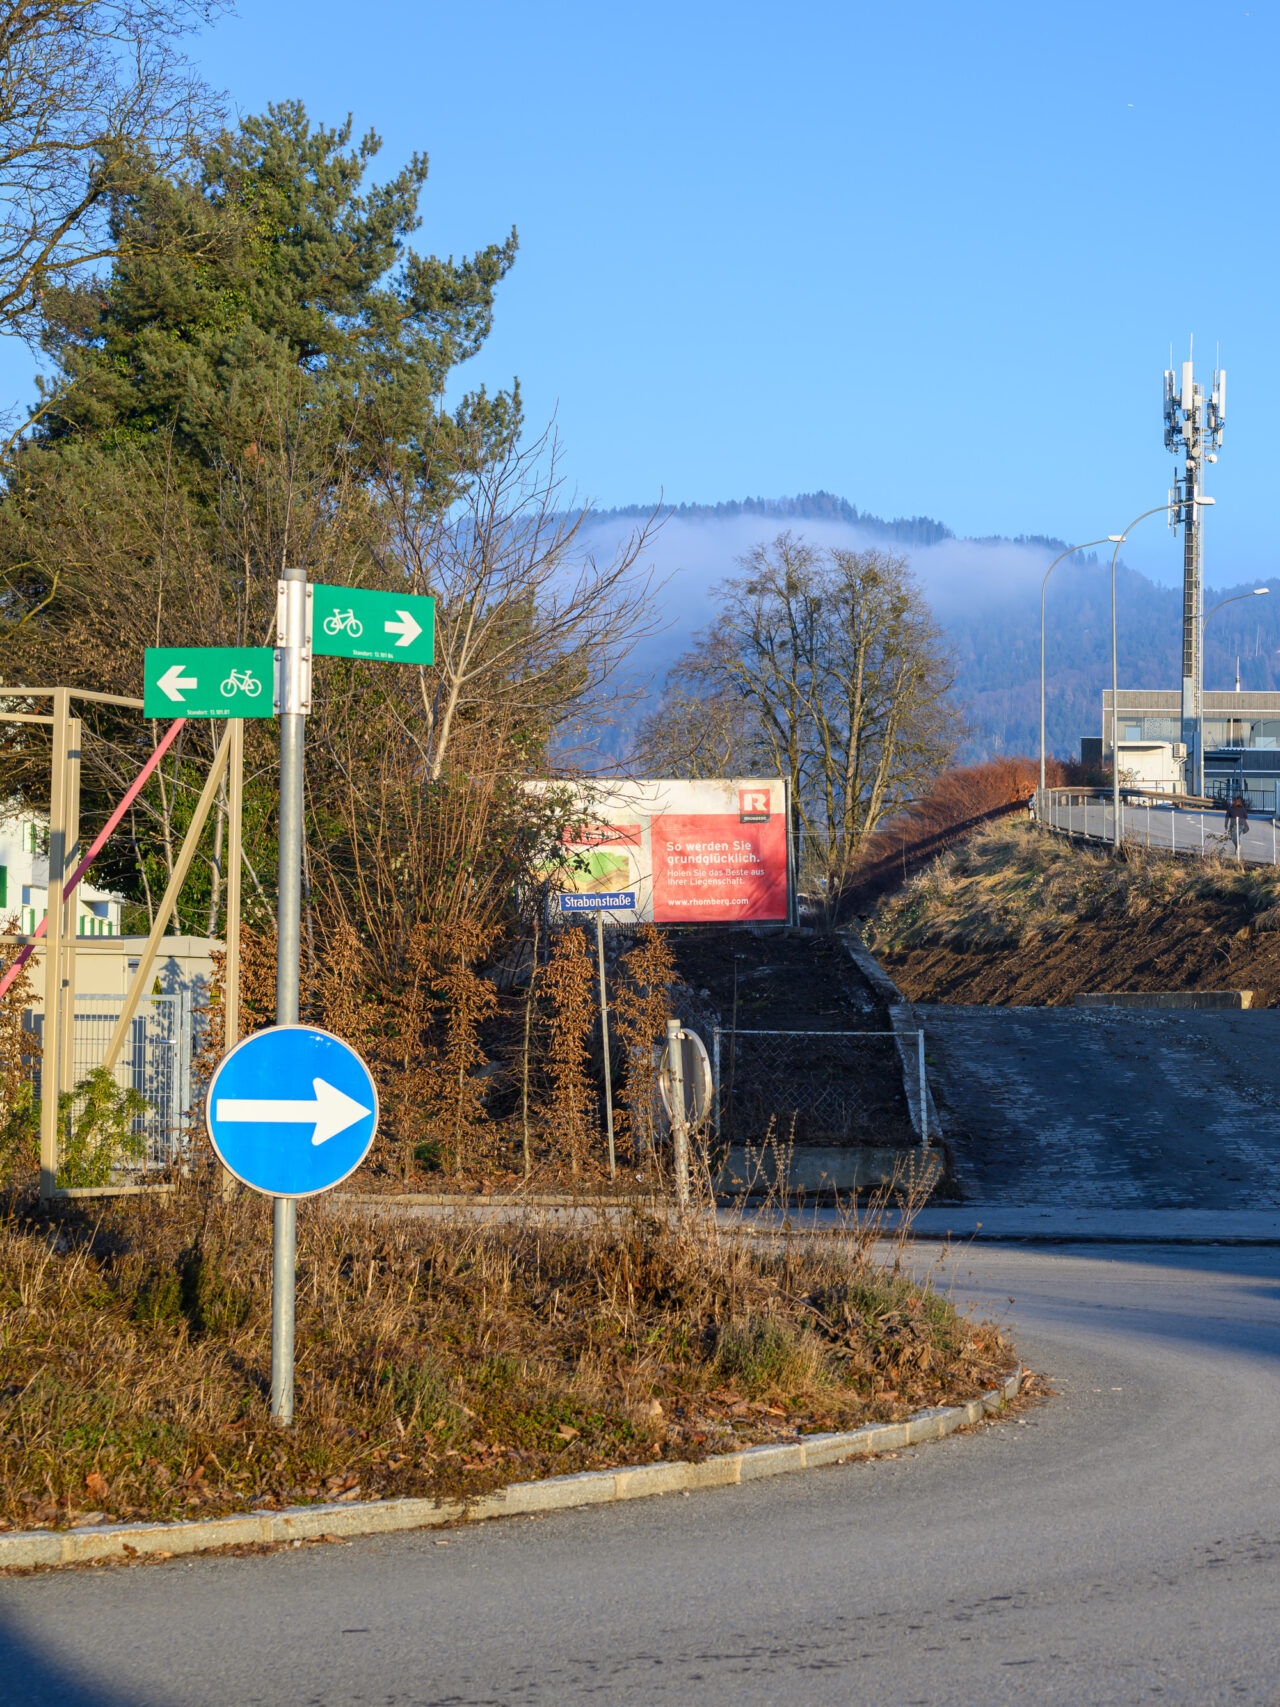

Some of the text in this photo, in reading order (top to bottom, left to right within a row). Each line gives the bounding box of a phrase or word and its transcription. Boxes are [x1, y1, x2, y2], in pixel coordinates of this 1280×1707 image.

[743, 793, 768, 811] R
[666, 840, 752, 852] So werden Sie
[667, 852, 761, 866] grundglücklich.
[667, 868, 765, 877] Holen Sie das Beste aus
[667, 877, 745, 888] Ihrer Liegenschaft.
[564, 894, 631, 908] Strabonstraße
[668, 897, 749, 907] www.rhomberg.com
